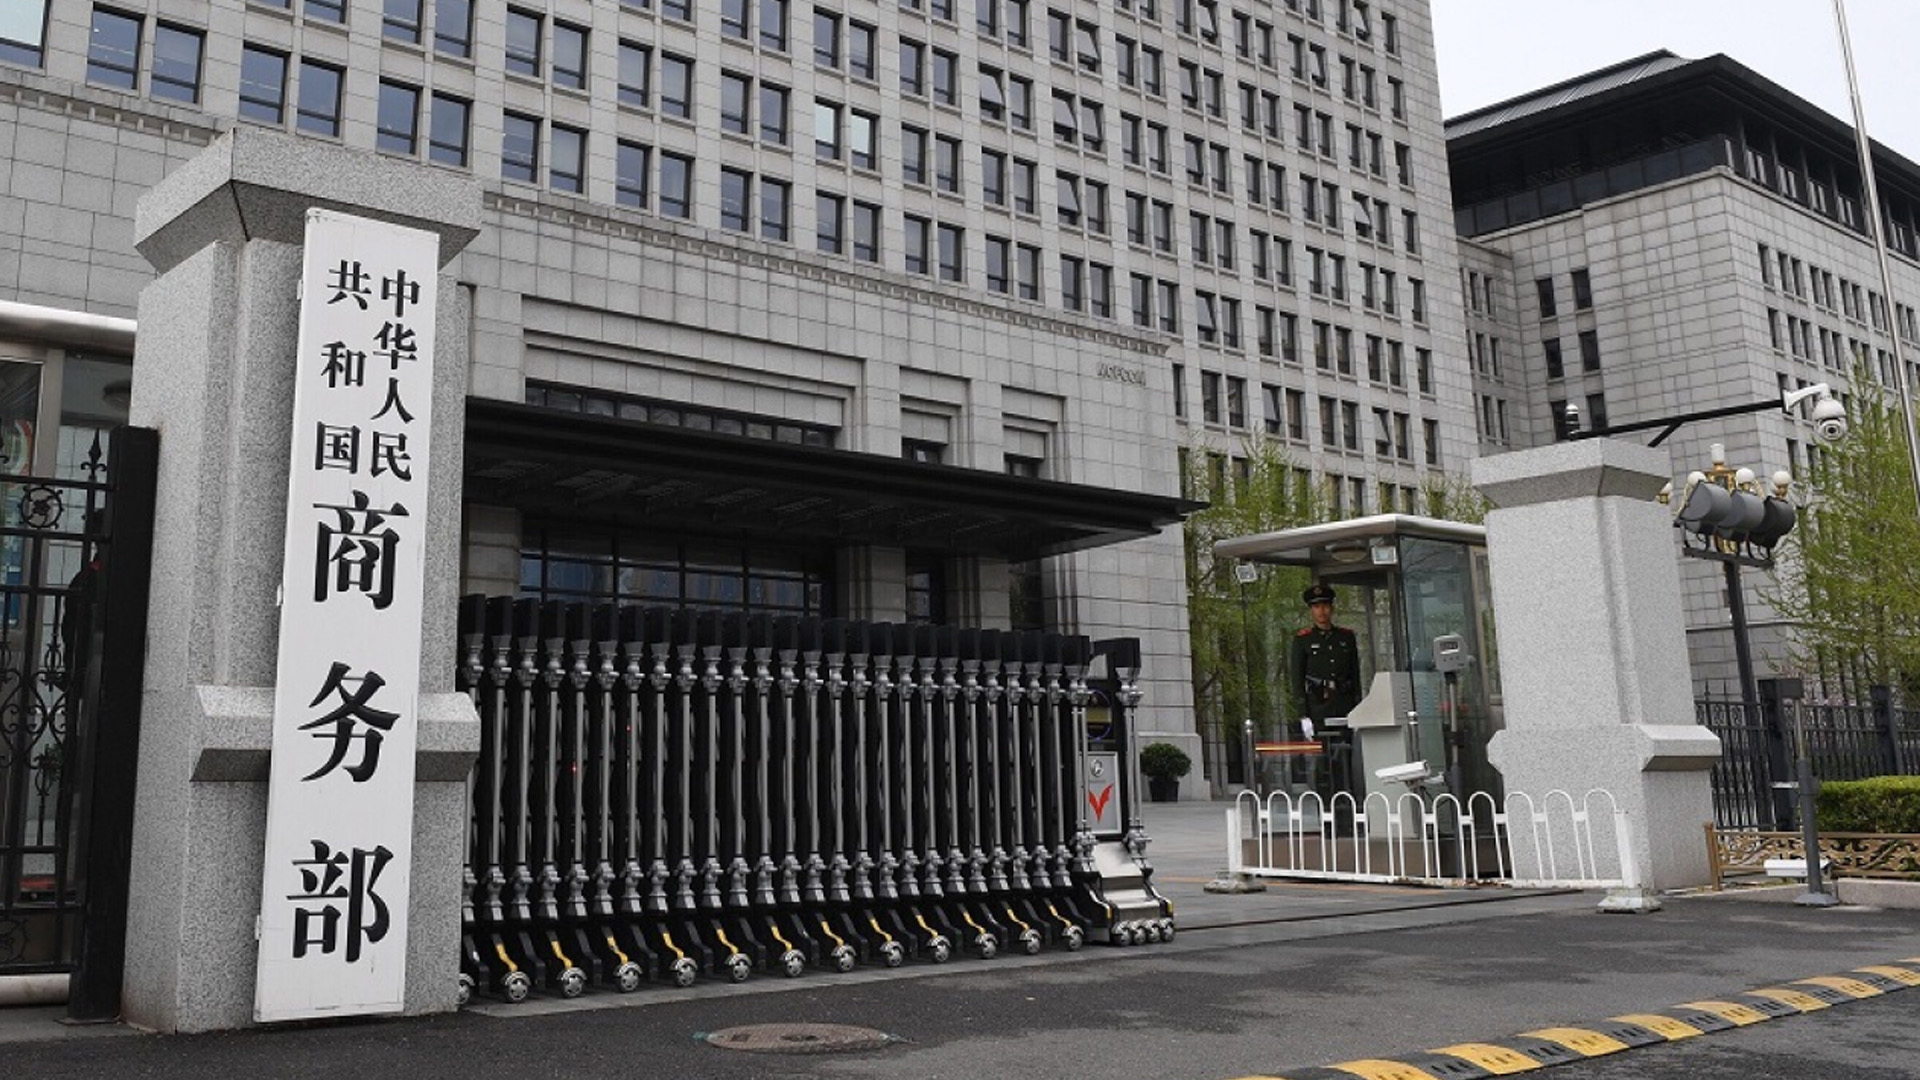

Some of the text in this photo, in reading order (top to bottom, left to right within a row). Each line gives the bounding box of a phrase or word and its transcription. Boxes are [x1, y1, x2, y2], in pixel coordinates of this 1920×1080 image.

[314, 259, 372, 475] 共和国
[371, 269, 420, 482] 中华人民
[285, 489, 411, 963] 商务部
